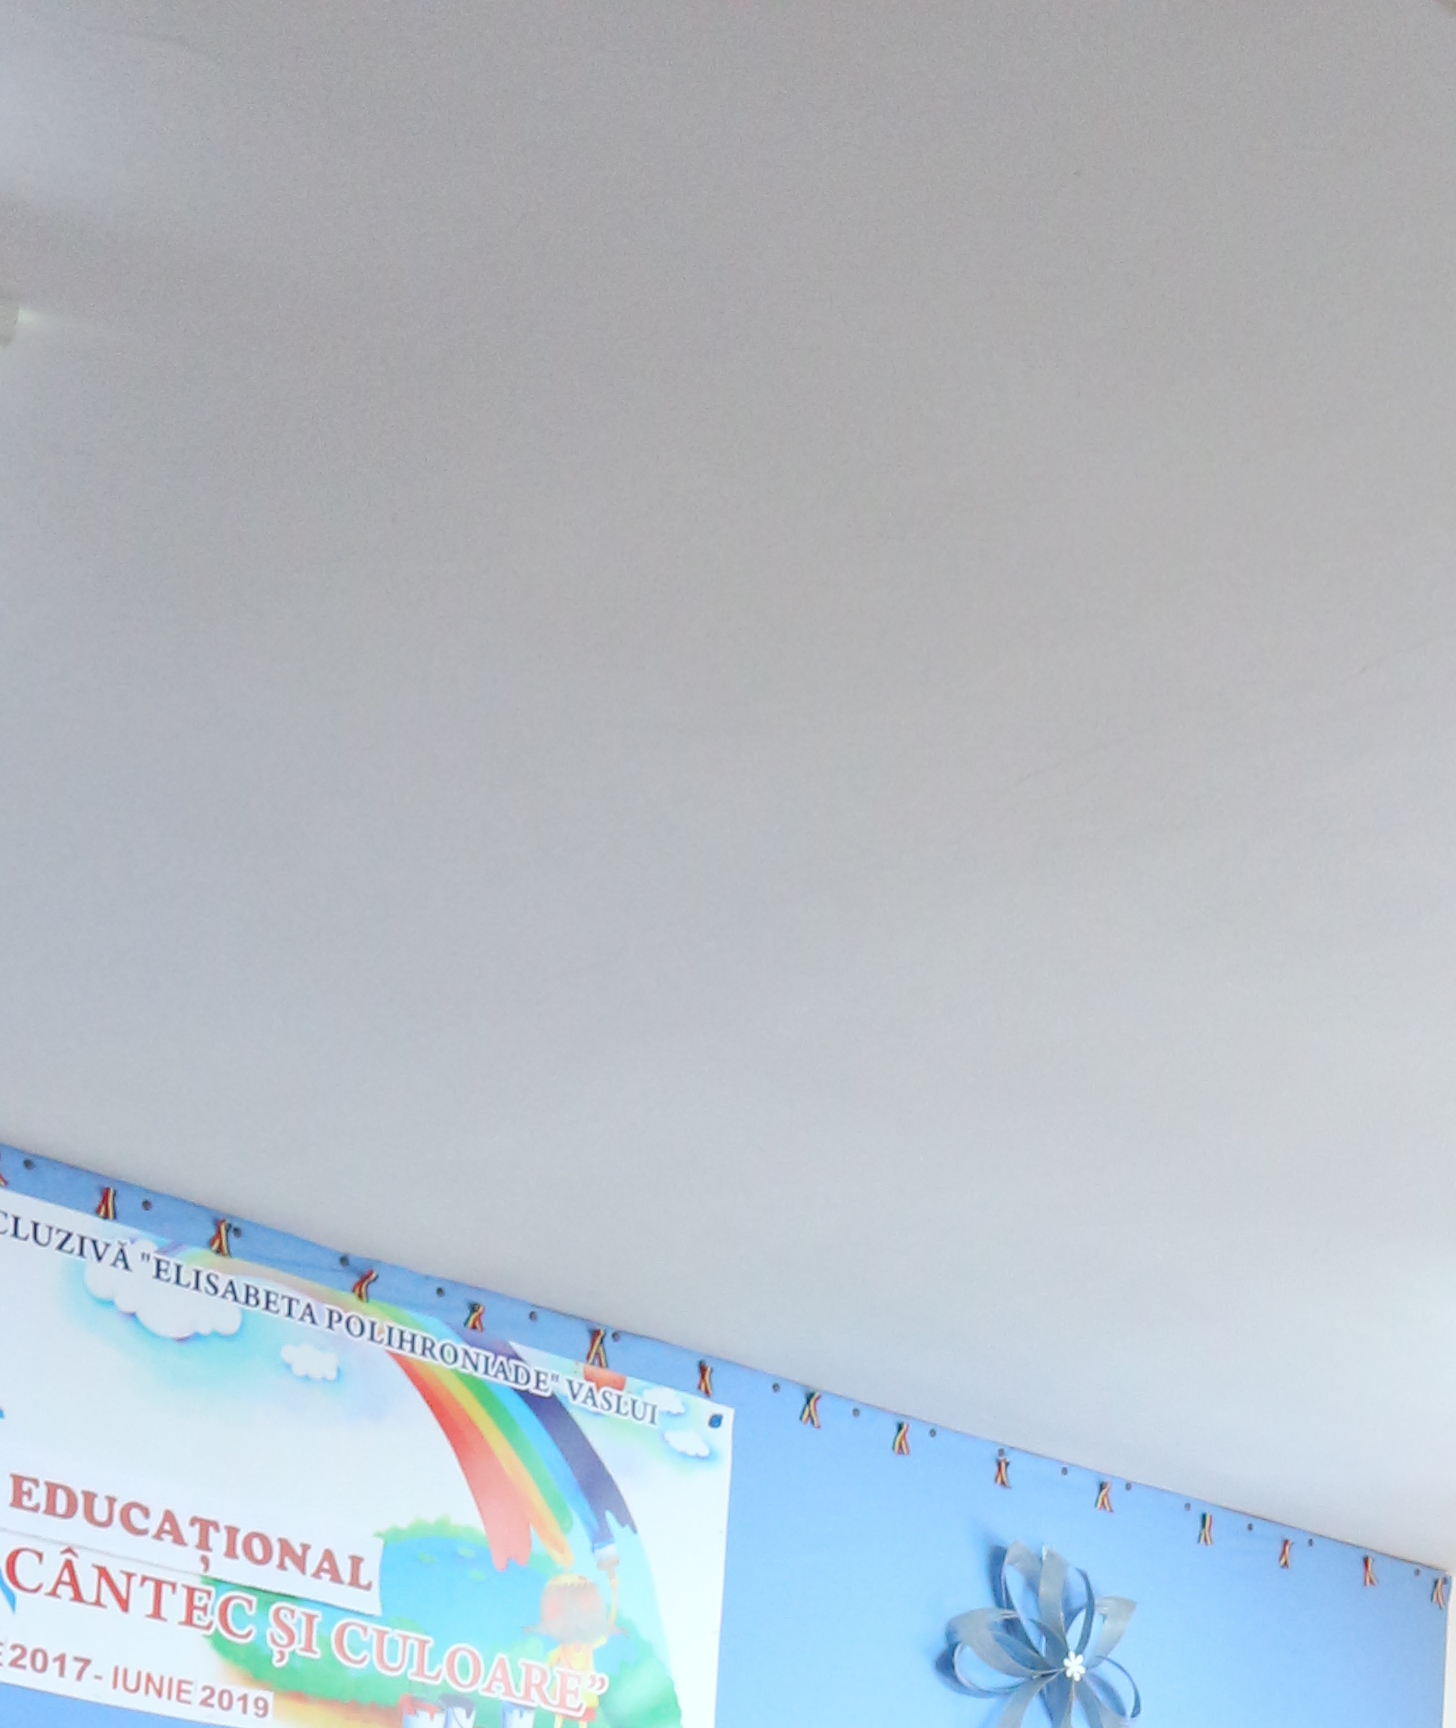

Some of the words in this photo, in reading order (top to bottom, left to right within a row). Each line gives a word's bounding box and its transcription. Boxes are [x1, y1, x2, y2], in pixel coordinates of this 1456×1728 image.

[140, 1251, 318, 1326] "ELISABETA
[326, 1307, 559, 1393] POLIHRONIADE"
[565, 1379, 658, 1426] VASLUI
[9, 1473, 373, 1592] EDUCAȚIONAL
[5, 1546, 254, 1640] CÂNTEC
[269, 1606, 321, 1664] ȘI
[112, 1665, 193, 1705] IUNIE
[199, 1685, 269, 1718] 2019
